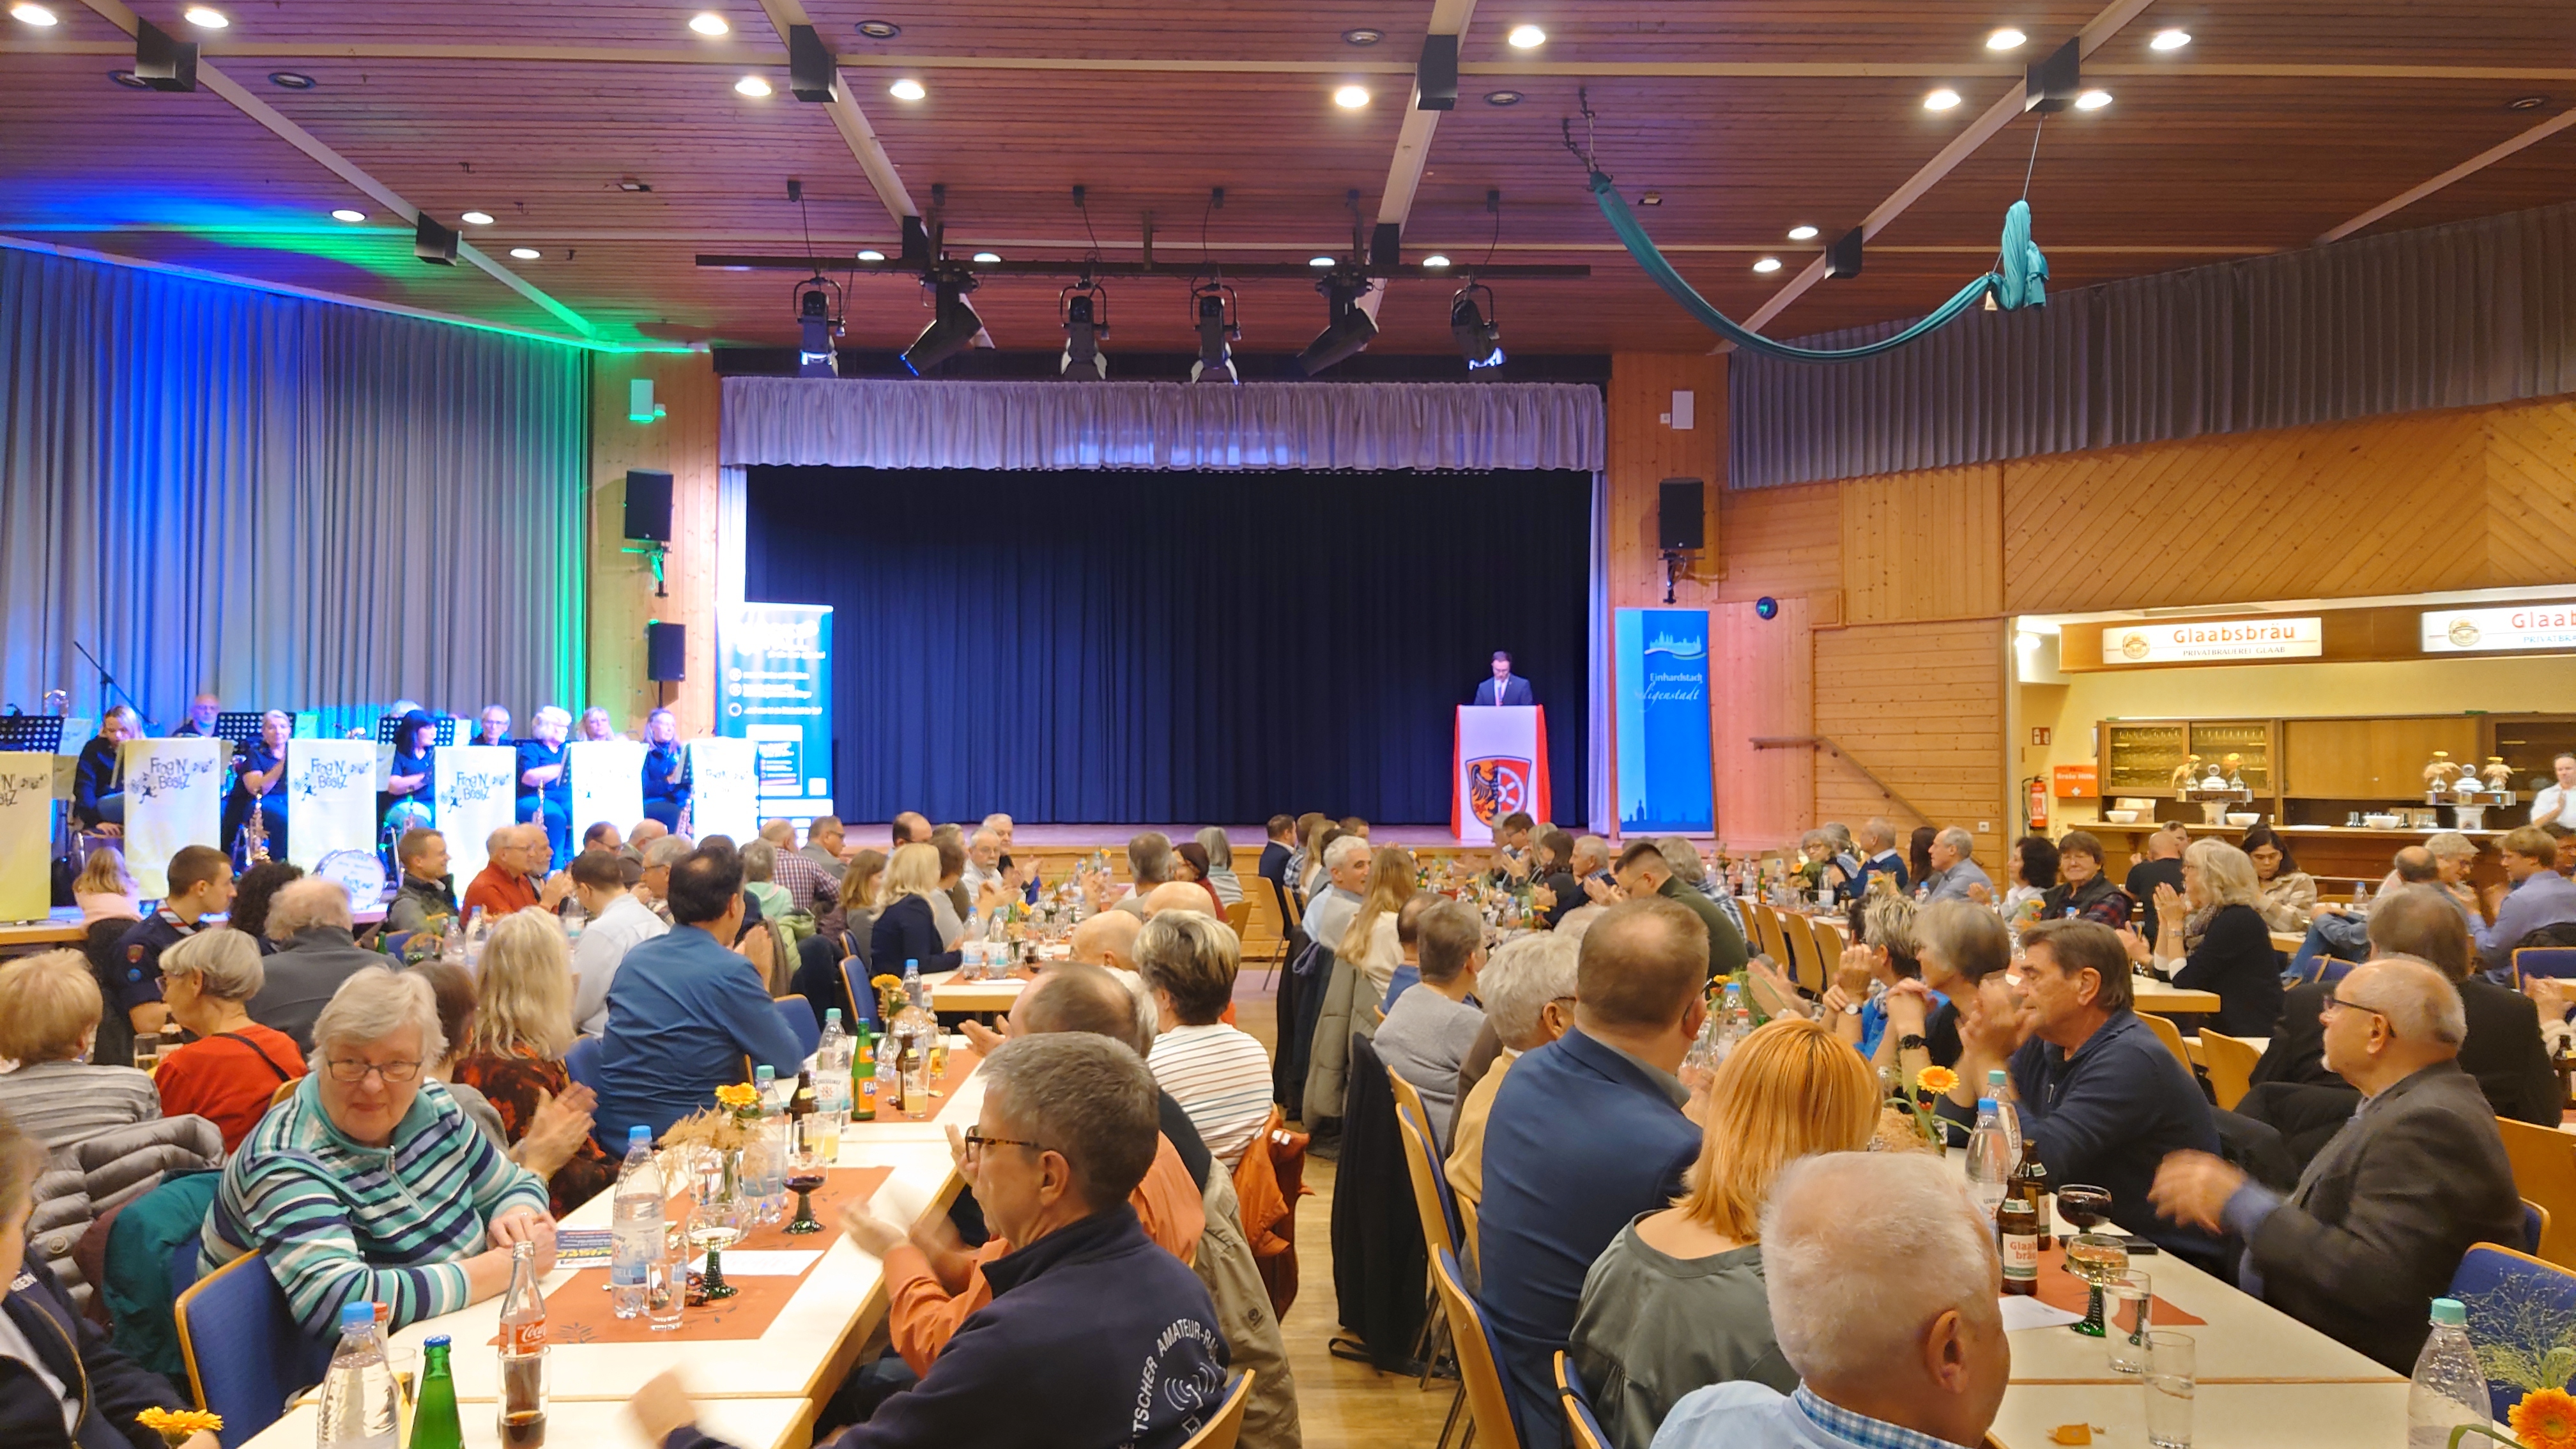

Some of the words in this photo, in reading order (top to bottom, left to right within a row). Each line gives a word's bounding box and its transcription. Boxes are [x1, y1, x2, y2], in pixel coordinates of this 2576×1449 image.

[2174, 623, 2296, 643] Glaabsbräu
[2183, 648, 2251, 657] PRIVATBRAUEREI
[2256, 646, 2286, 654] GLAAB
[1650, 672, 1703, 682] Einhardstadt
